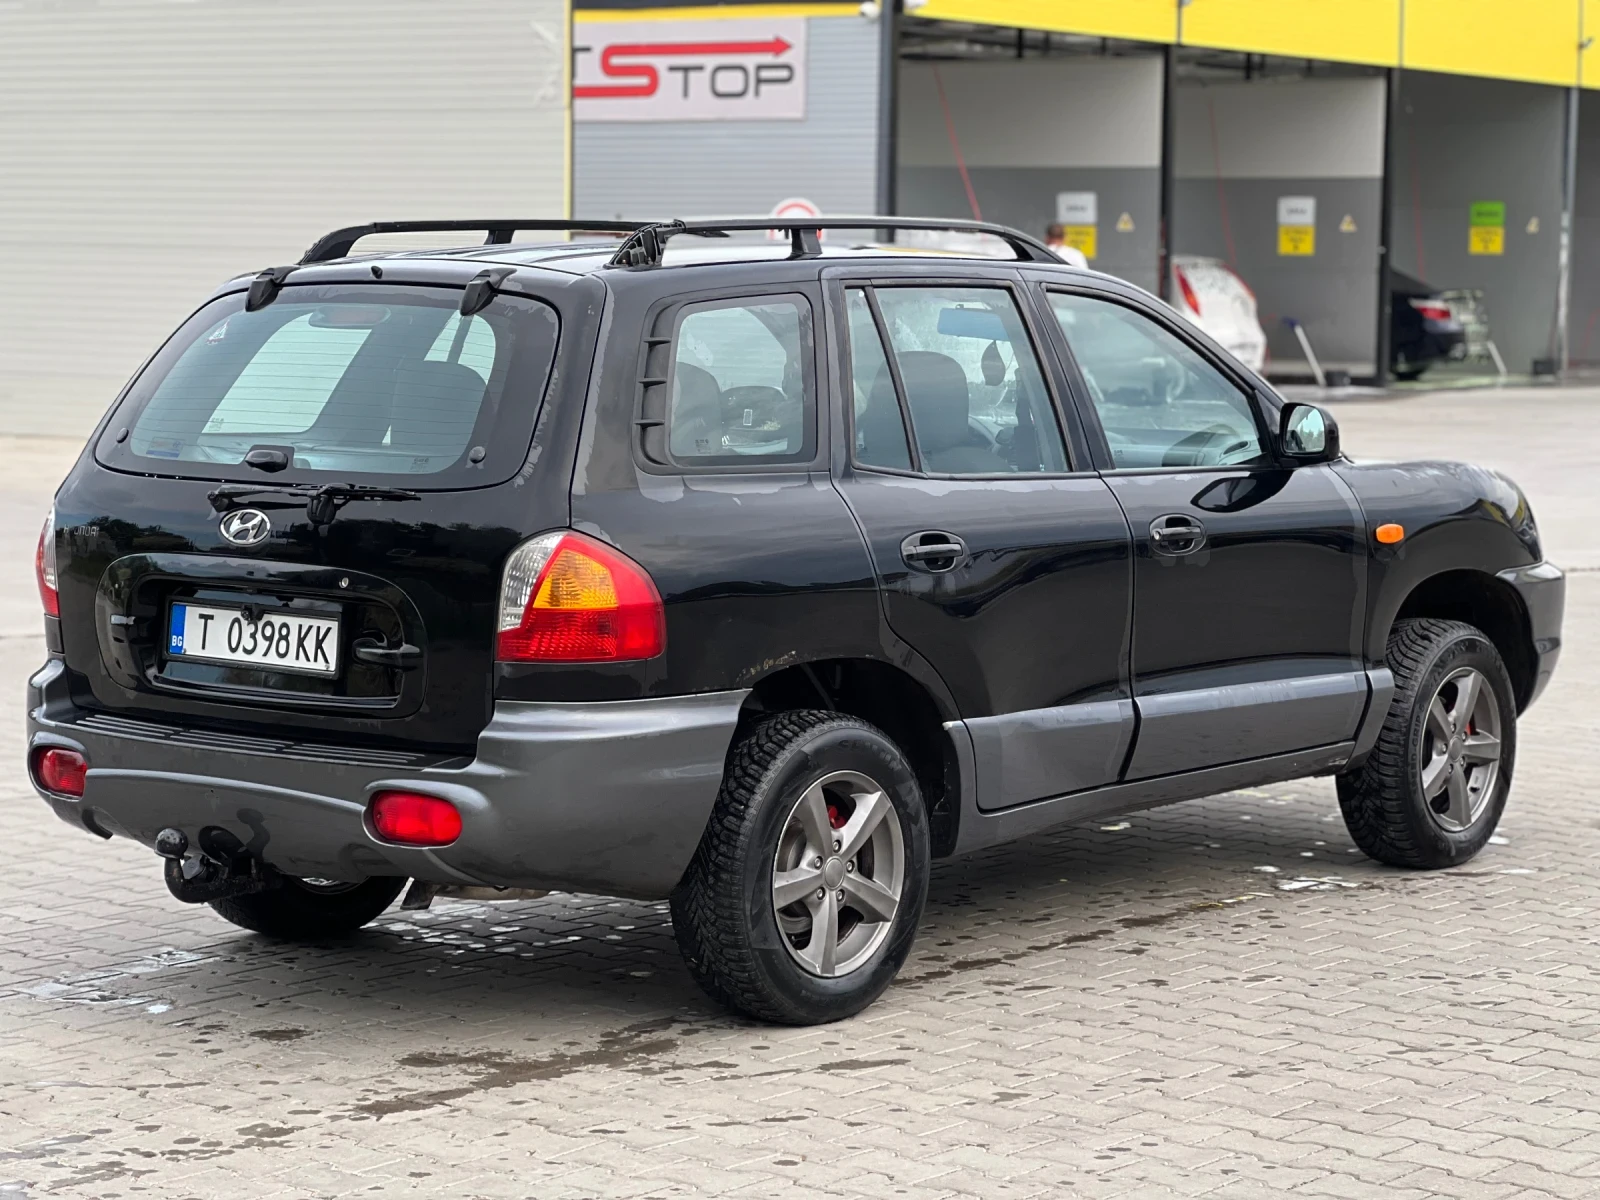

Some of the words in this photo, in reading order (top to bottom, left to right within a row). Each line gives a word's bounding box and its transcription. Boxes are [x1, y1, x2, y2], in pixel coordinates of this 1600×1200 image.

[600, 38, 794, 98] STOP
[171, 635, 183, 647] BG
[198, 613, 215, 650] T
